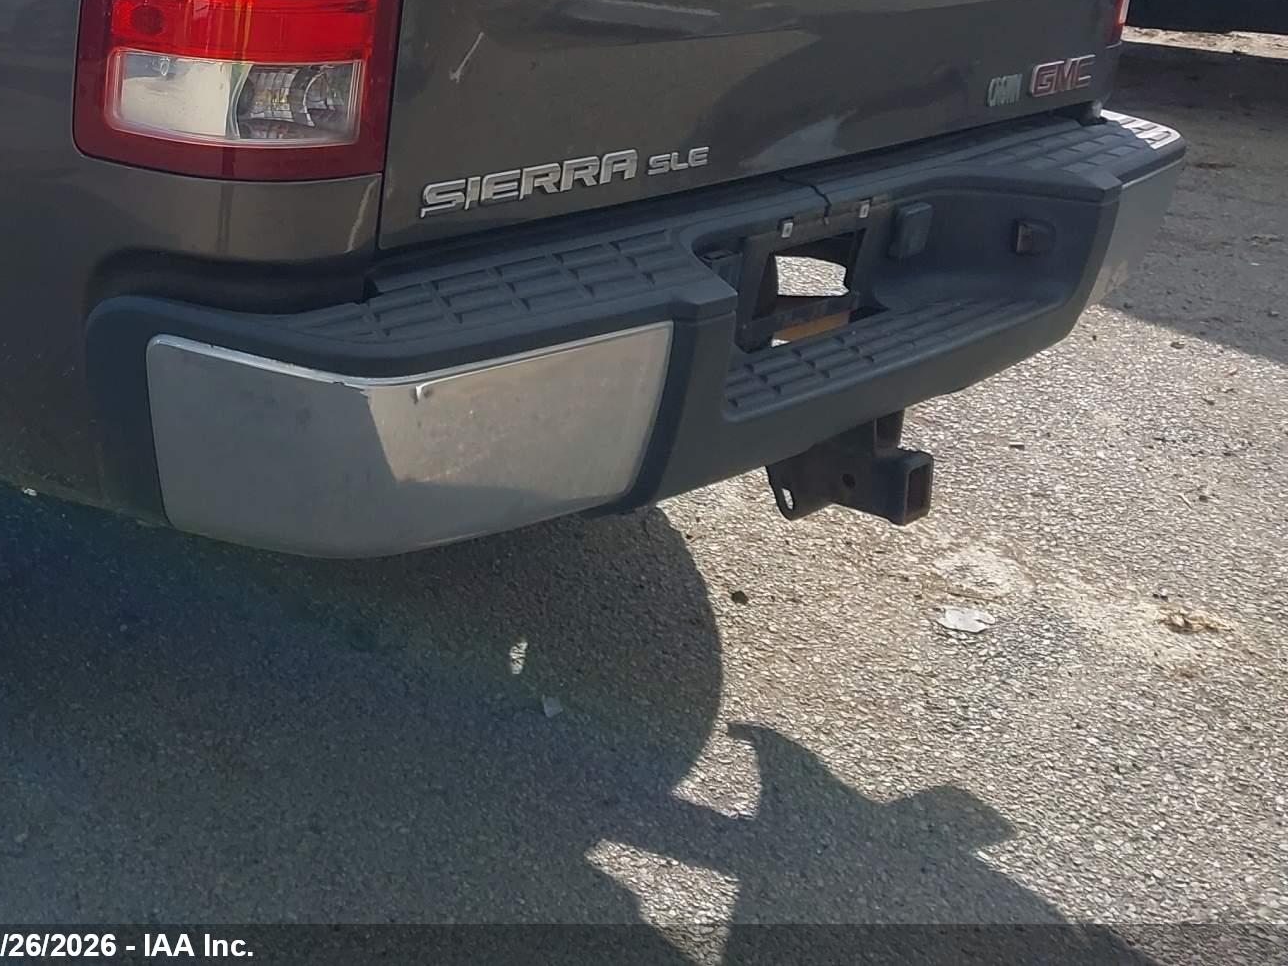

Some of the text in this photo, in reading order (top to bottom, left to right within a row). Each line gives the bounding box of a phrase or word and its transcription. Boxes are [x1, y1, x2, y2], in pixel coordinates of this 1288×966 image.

[1031, 54, 1096, 97] GMC
[420, 146, 710, 218] SIERRA SLE
